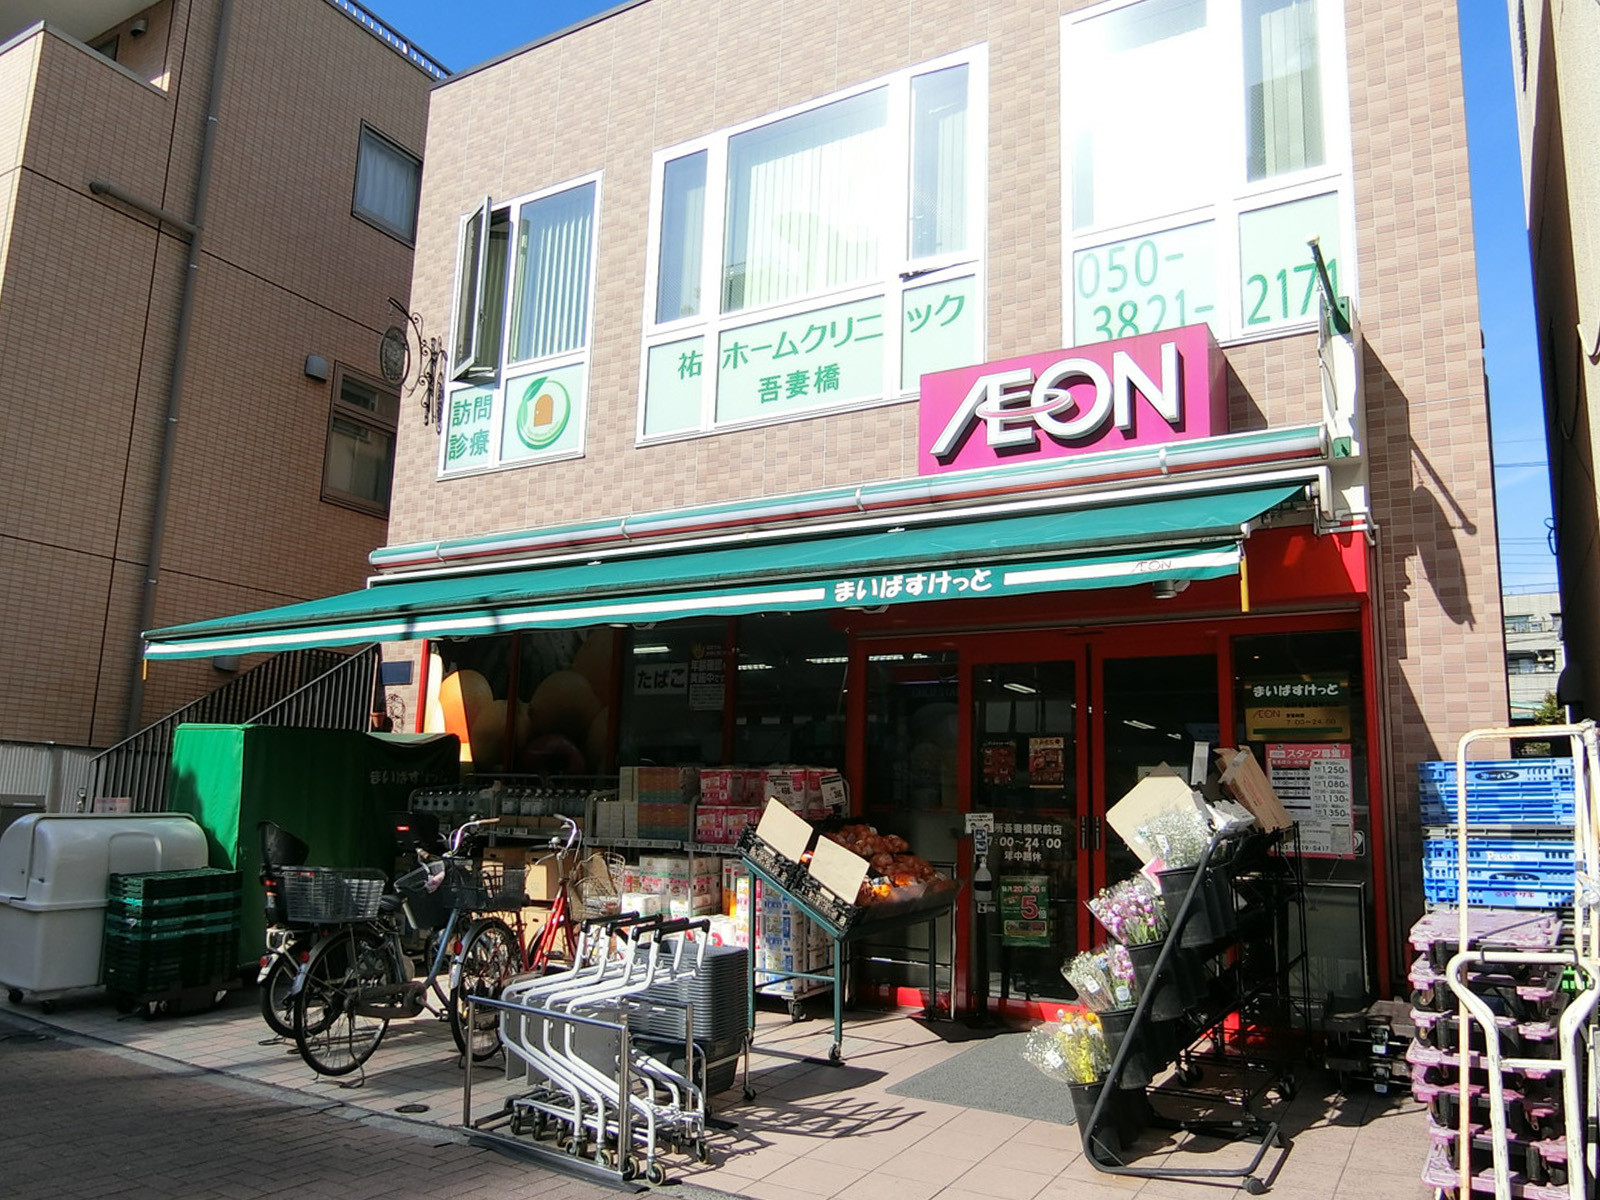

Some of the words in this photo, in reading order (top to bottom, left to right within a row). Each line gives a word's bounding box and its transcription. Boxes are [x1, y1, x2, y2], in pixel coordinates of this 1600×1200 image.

[1077, 239, 1184, 299] 050-
[1246, 258, 1341, 325] 2171
[757, 363, 841, 404] 吾妻橋
[451, 393, 493, 428] 訪問
[448, 431, 489, 462] 診療
[833, 569, 993, 602] まいばすけっと
[637, 668, 685, 689] たばこ
[1253, 683, 1339, 697] まいばすけっと
